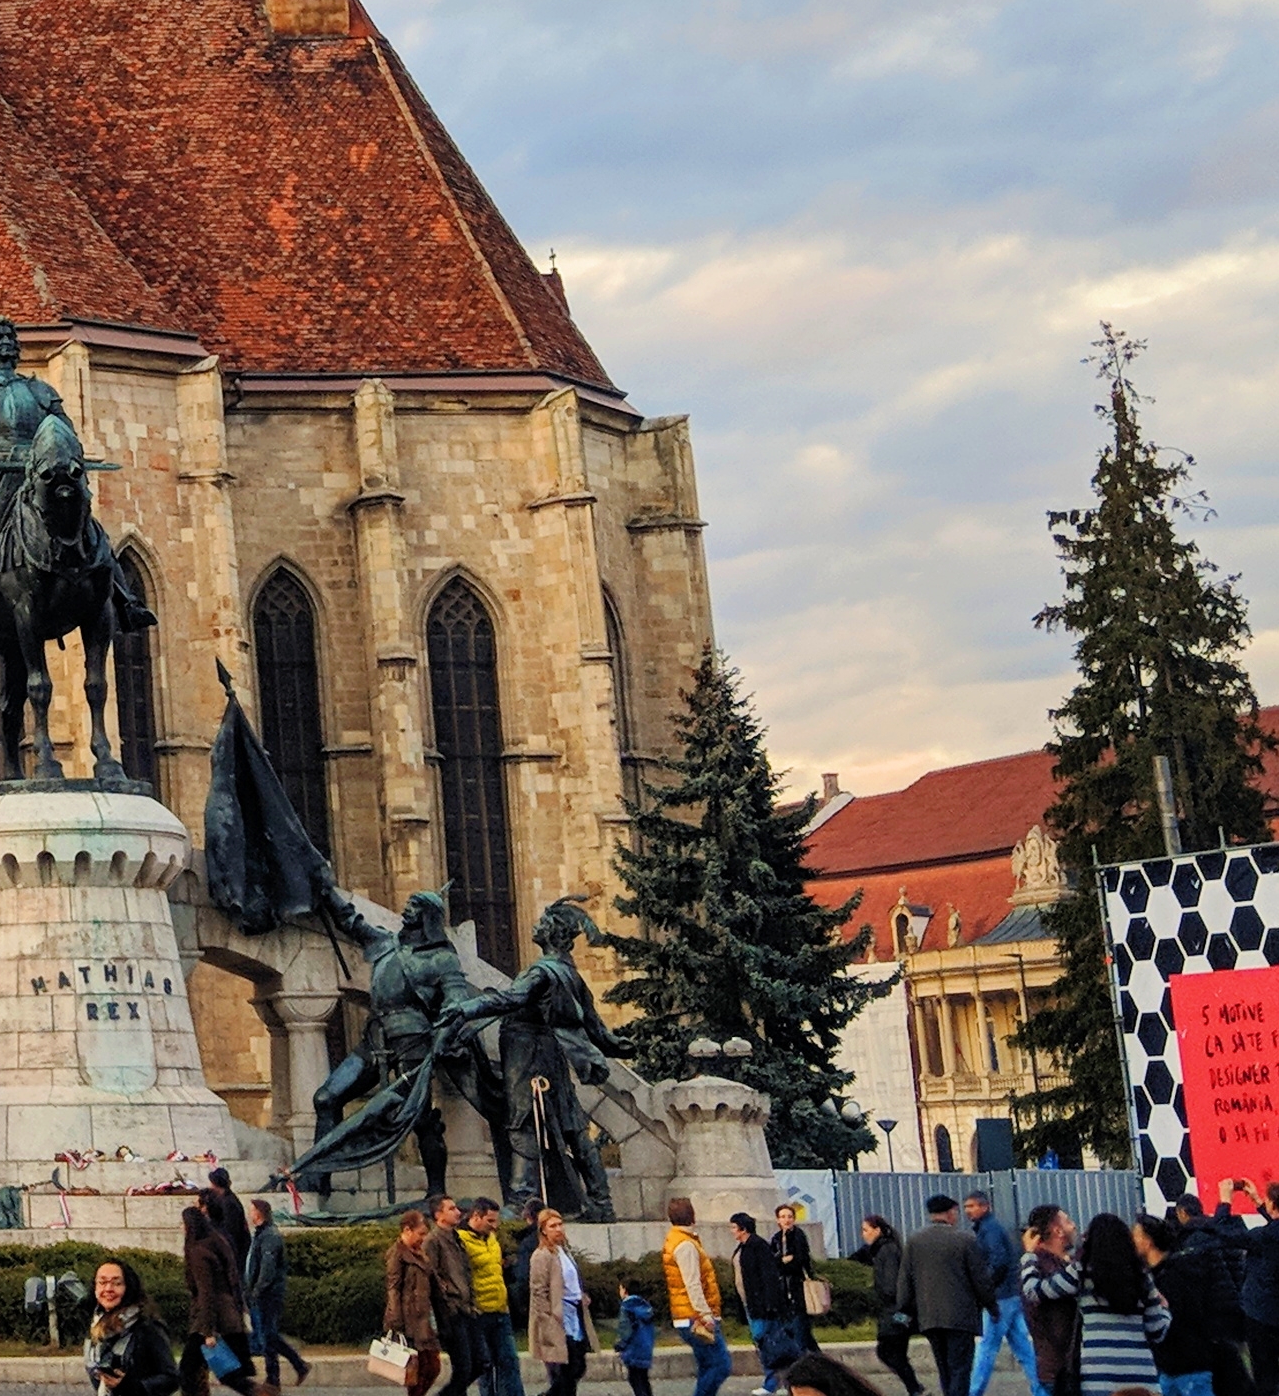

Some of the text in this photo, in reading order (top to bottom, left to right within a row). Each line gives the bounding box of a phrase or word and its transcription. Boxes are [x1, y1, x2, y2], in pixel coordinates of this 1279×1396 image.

[31, 965, 172, 995] MATHIAS
[86, 1002, 140, 1021] REX
[1202, 1004, 1210, 1025] 5
